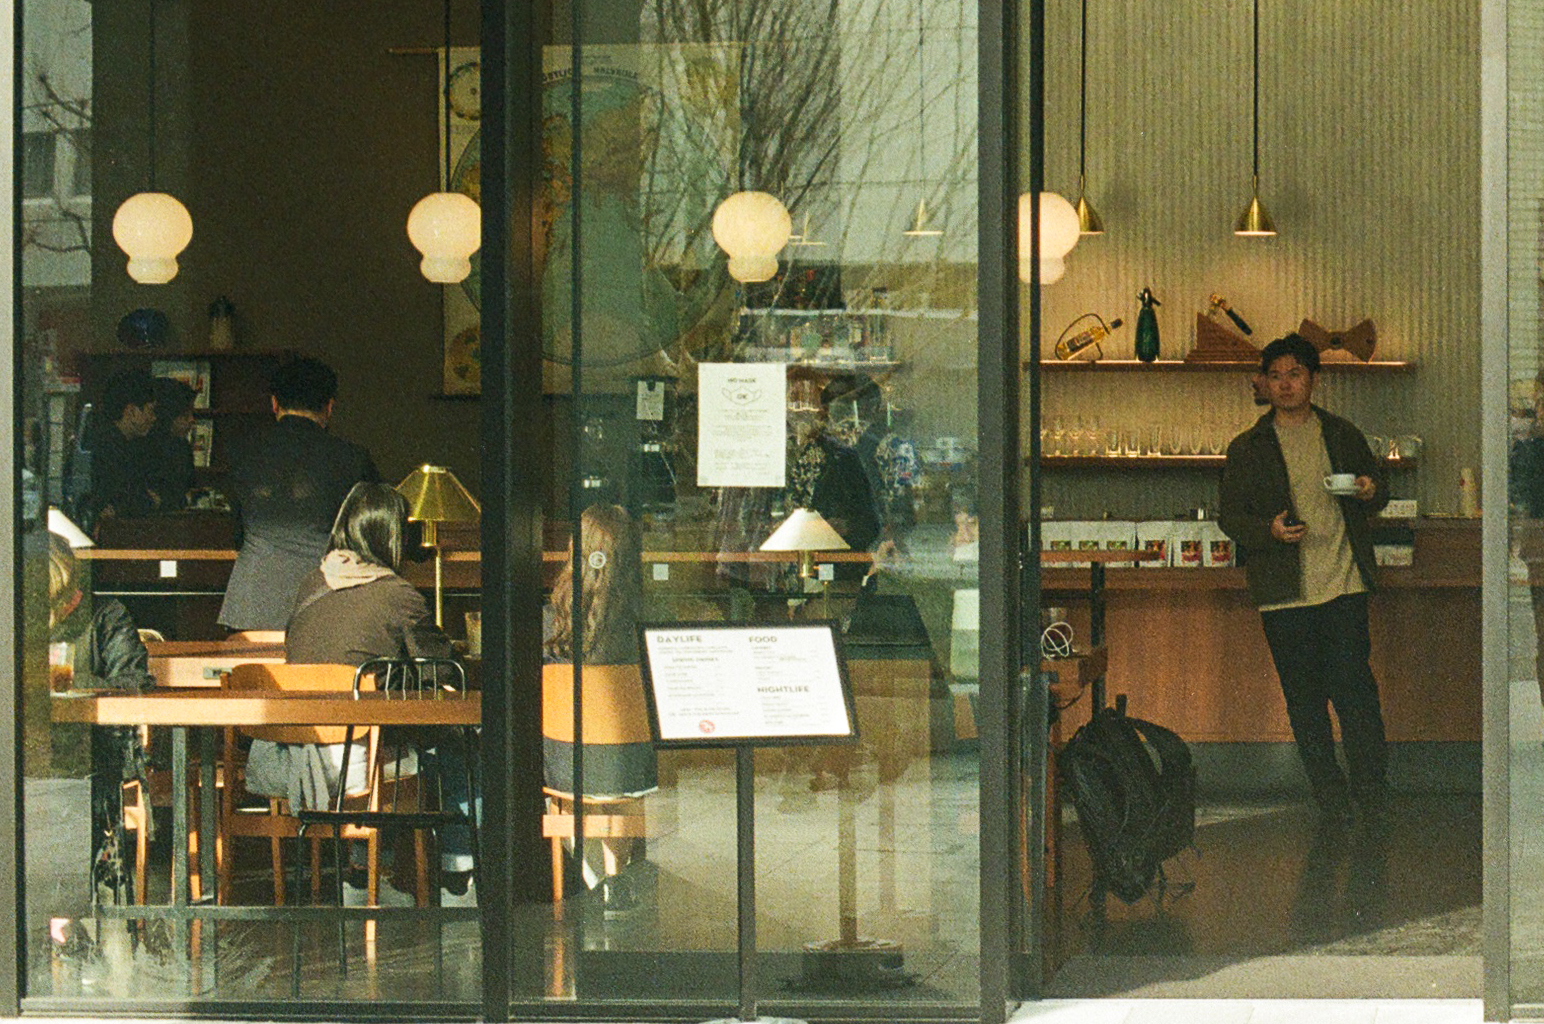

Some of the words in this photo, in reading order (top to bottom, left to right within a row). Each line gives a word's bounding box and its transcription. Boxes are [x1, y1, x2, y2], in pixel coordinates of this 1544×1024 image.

[656, 635, 703, 644] DAYLIFE
[748, 635, 778, 644] FOOD
[757, 685, 811, 694] NIGHTLIFE
